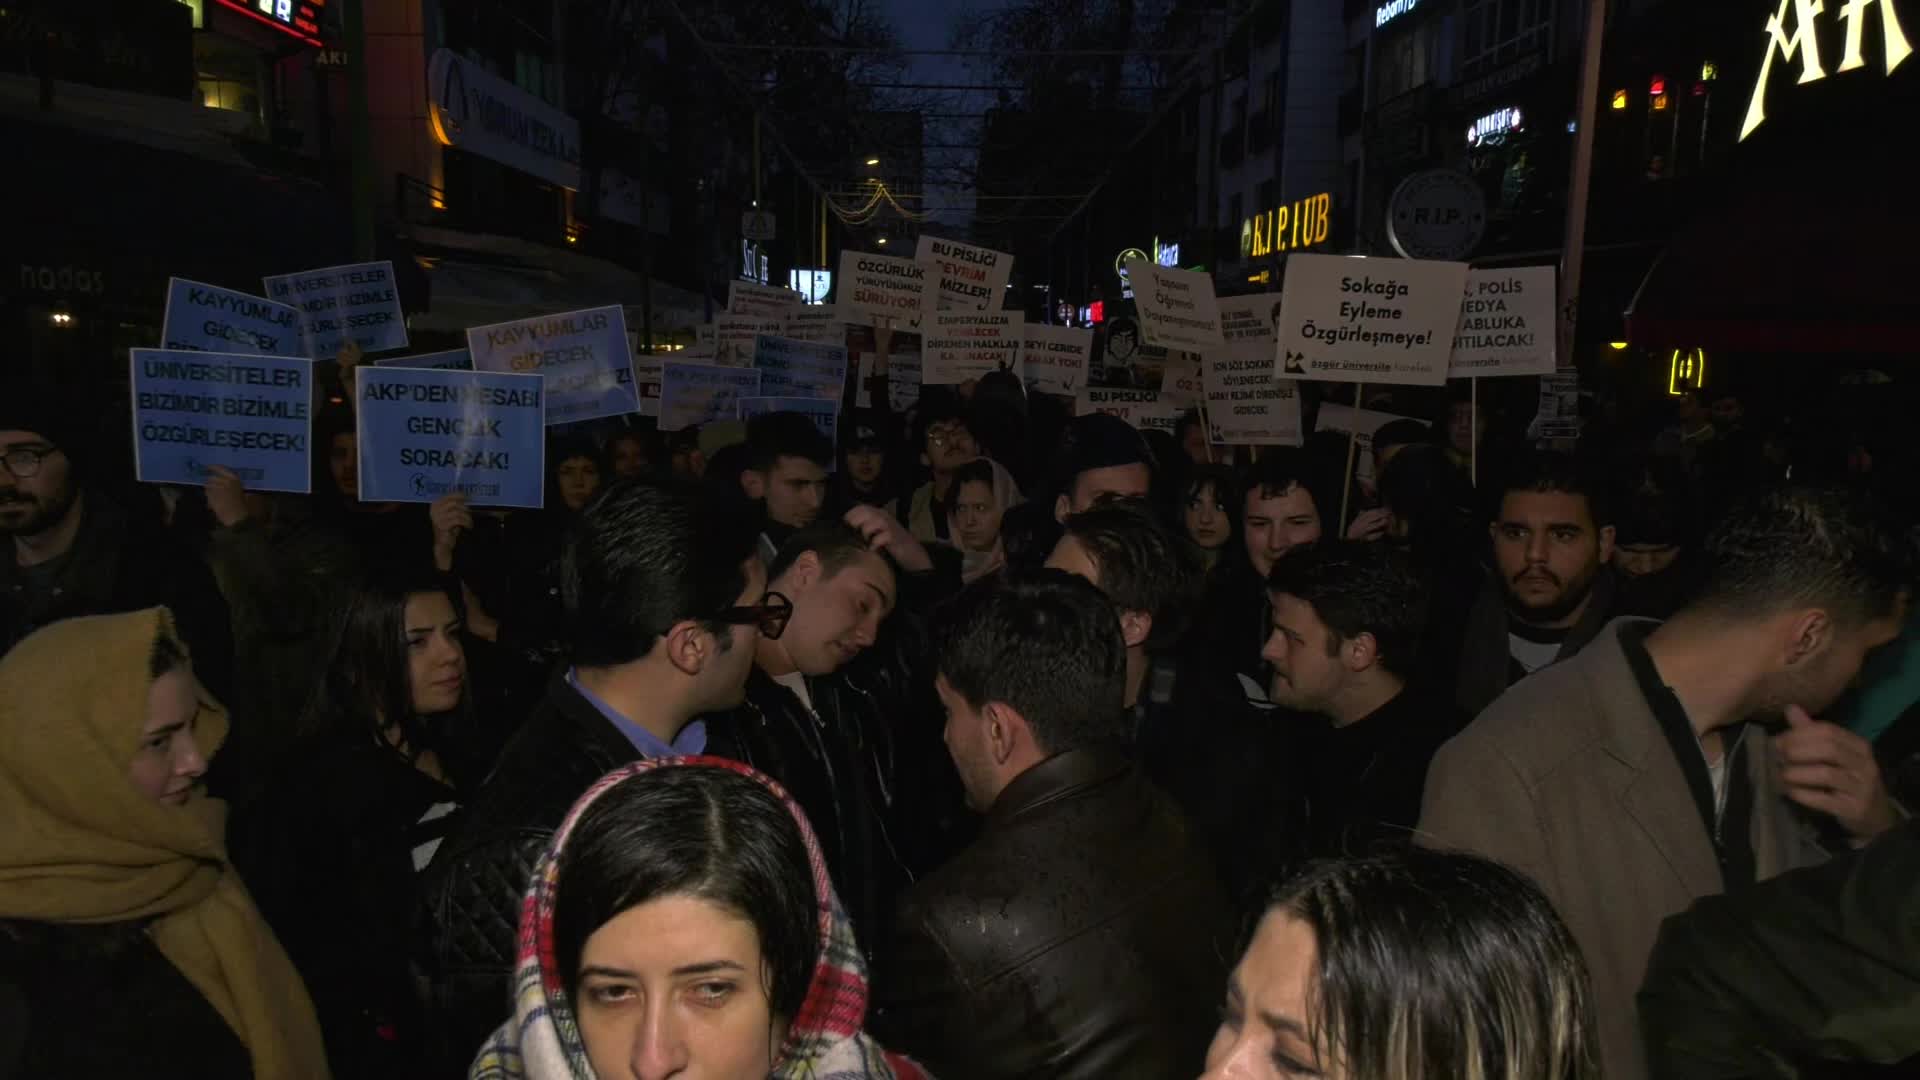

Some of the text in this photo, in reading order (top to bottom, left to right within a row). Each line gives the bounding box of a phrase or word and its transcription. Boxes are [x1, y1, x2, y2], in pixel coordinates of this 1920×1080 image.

[931, 241, 950, 257] BU
[943, 262, 986, 281] EVRİM
[1340, 276, 1409, 300] Sokağa
[1479, 278, 1523, 295] POLİS
[1339, 302, 1402, 322] Eyleme
[1301, 320, 1433, 349] Özgürleşmeye!
[365, 382, 458, 402] AKP'DEN
[400, 448, 509, 470] SORACAK!
